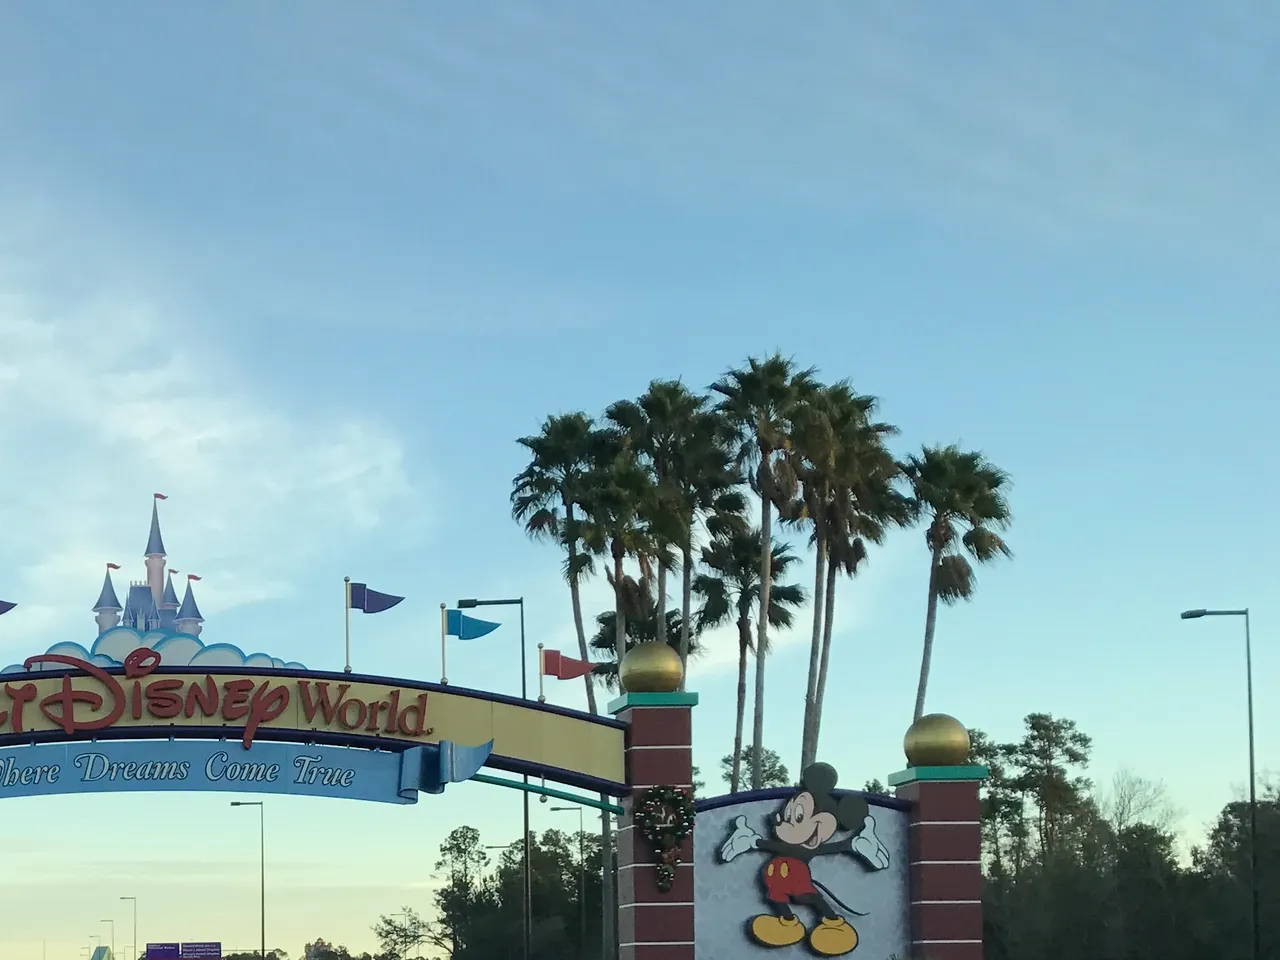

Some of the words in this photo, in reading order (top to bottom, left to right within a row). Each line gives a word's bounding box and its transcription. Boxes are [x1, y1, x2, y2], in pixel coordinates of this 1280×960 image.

[74, 753, 190, 782] Dreams
[205, 751, 280, 782] Come
[293, 755, 355, 787] True
